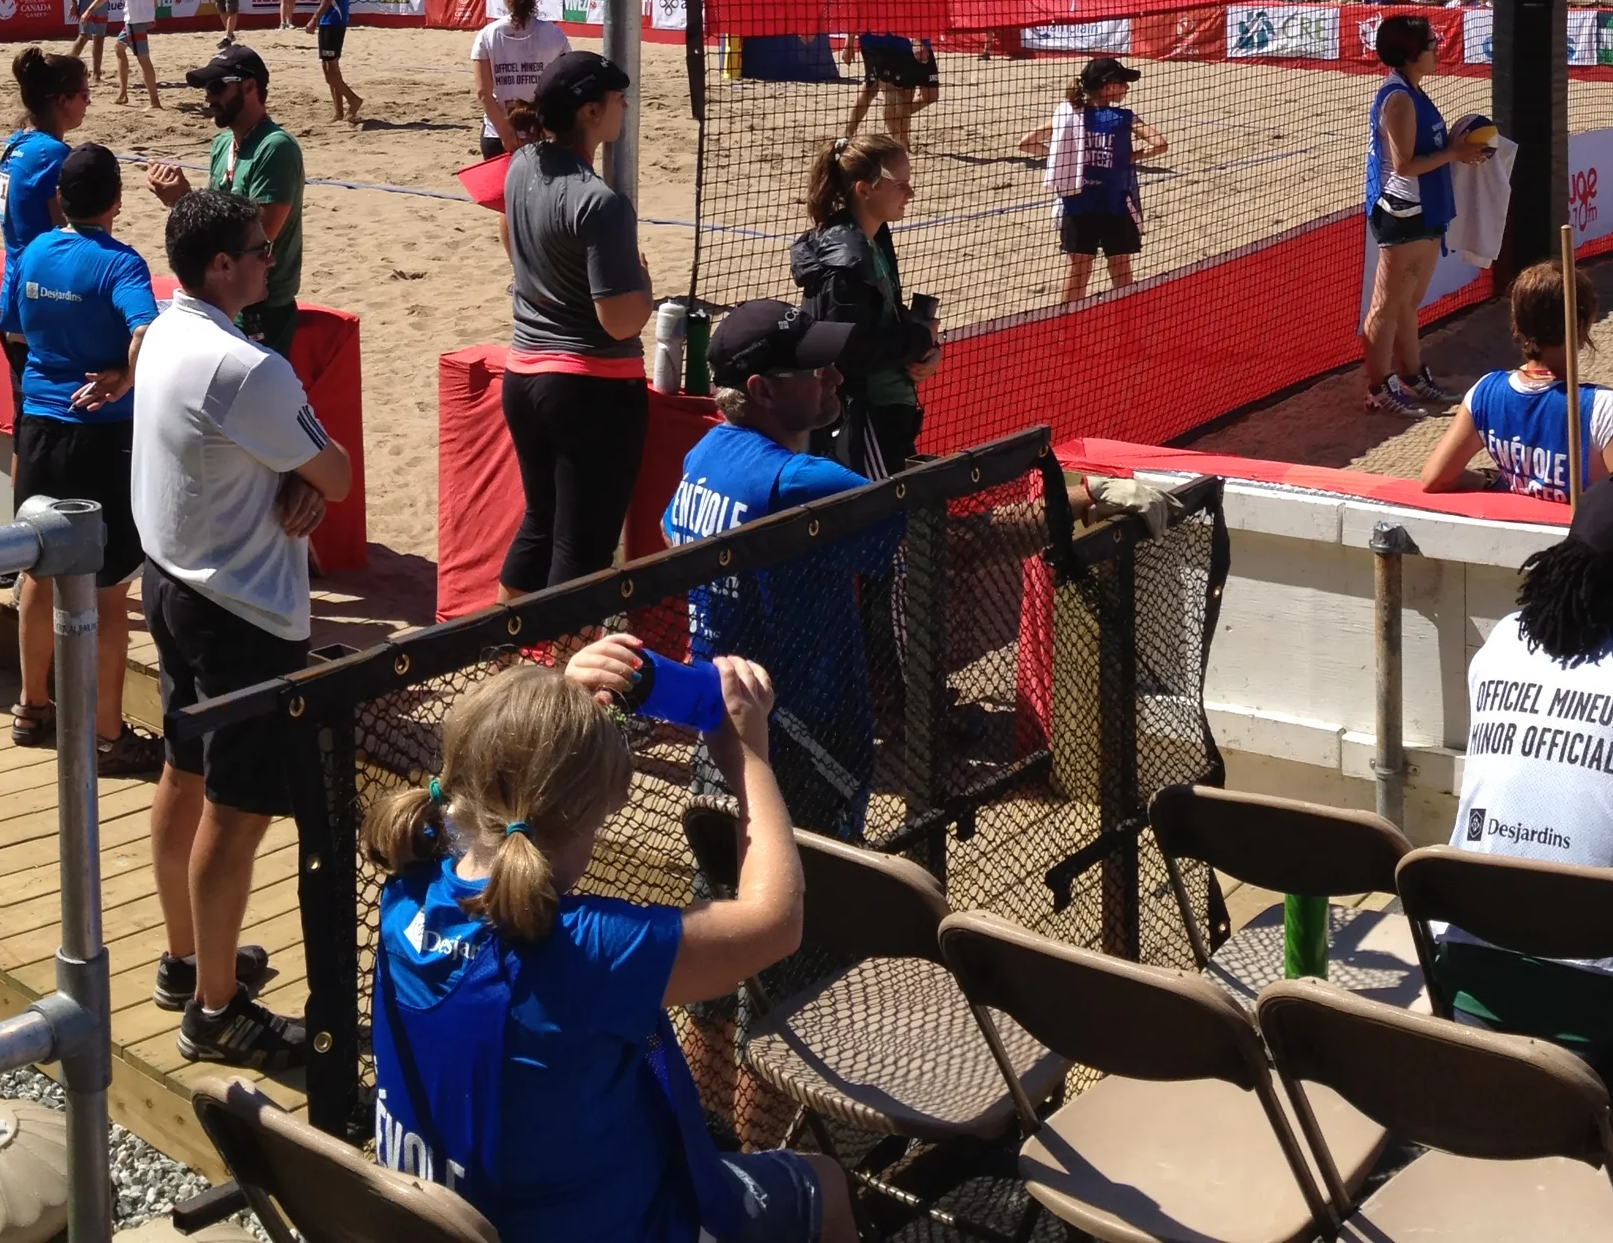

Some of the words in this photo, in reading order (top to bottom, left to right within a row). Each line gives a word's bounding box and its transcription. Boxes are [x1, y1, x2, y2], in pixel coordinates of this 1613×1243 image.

[20, 3, 52, 12] CANADA
[39, 286, 83, 303] Desjardins
[1476, 679, 1543, 715] OFFICIEL
[1469, 724, 1514, 756] MINOR
[1487, 818, 1571, 850] Desjardins
